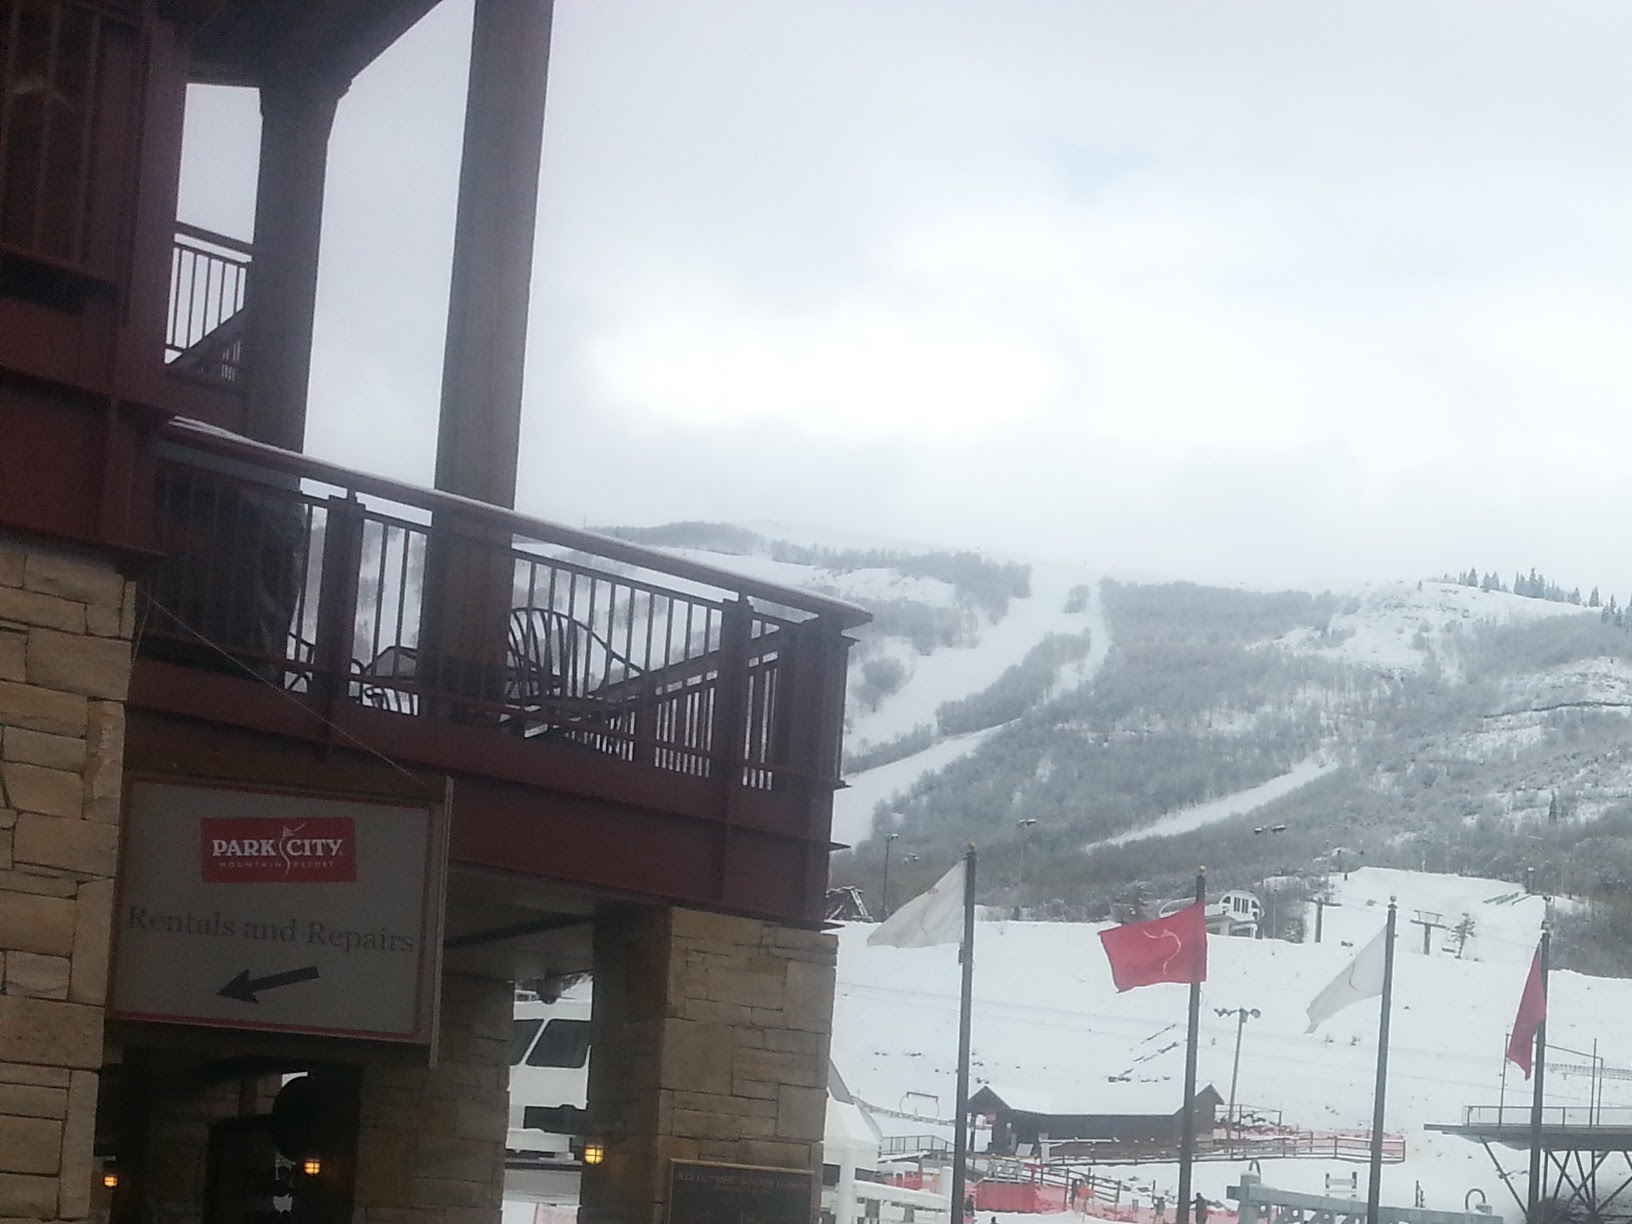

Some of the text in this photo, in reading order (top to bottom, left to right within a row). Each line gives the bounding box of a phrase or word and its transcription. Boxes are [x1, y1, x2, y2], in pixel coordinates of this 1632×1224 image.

[211, 838, 343, 857] PARK CITY
[129, 905, 413, 952] Rentals and Repairs
